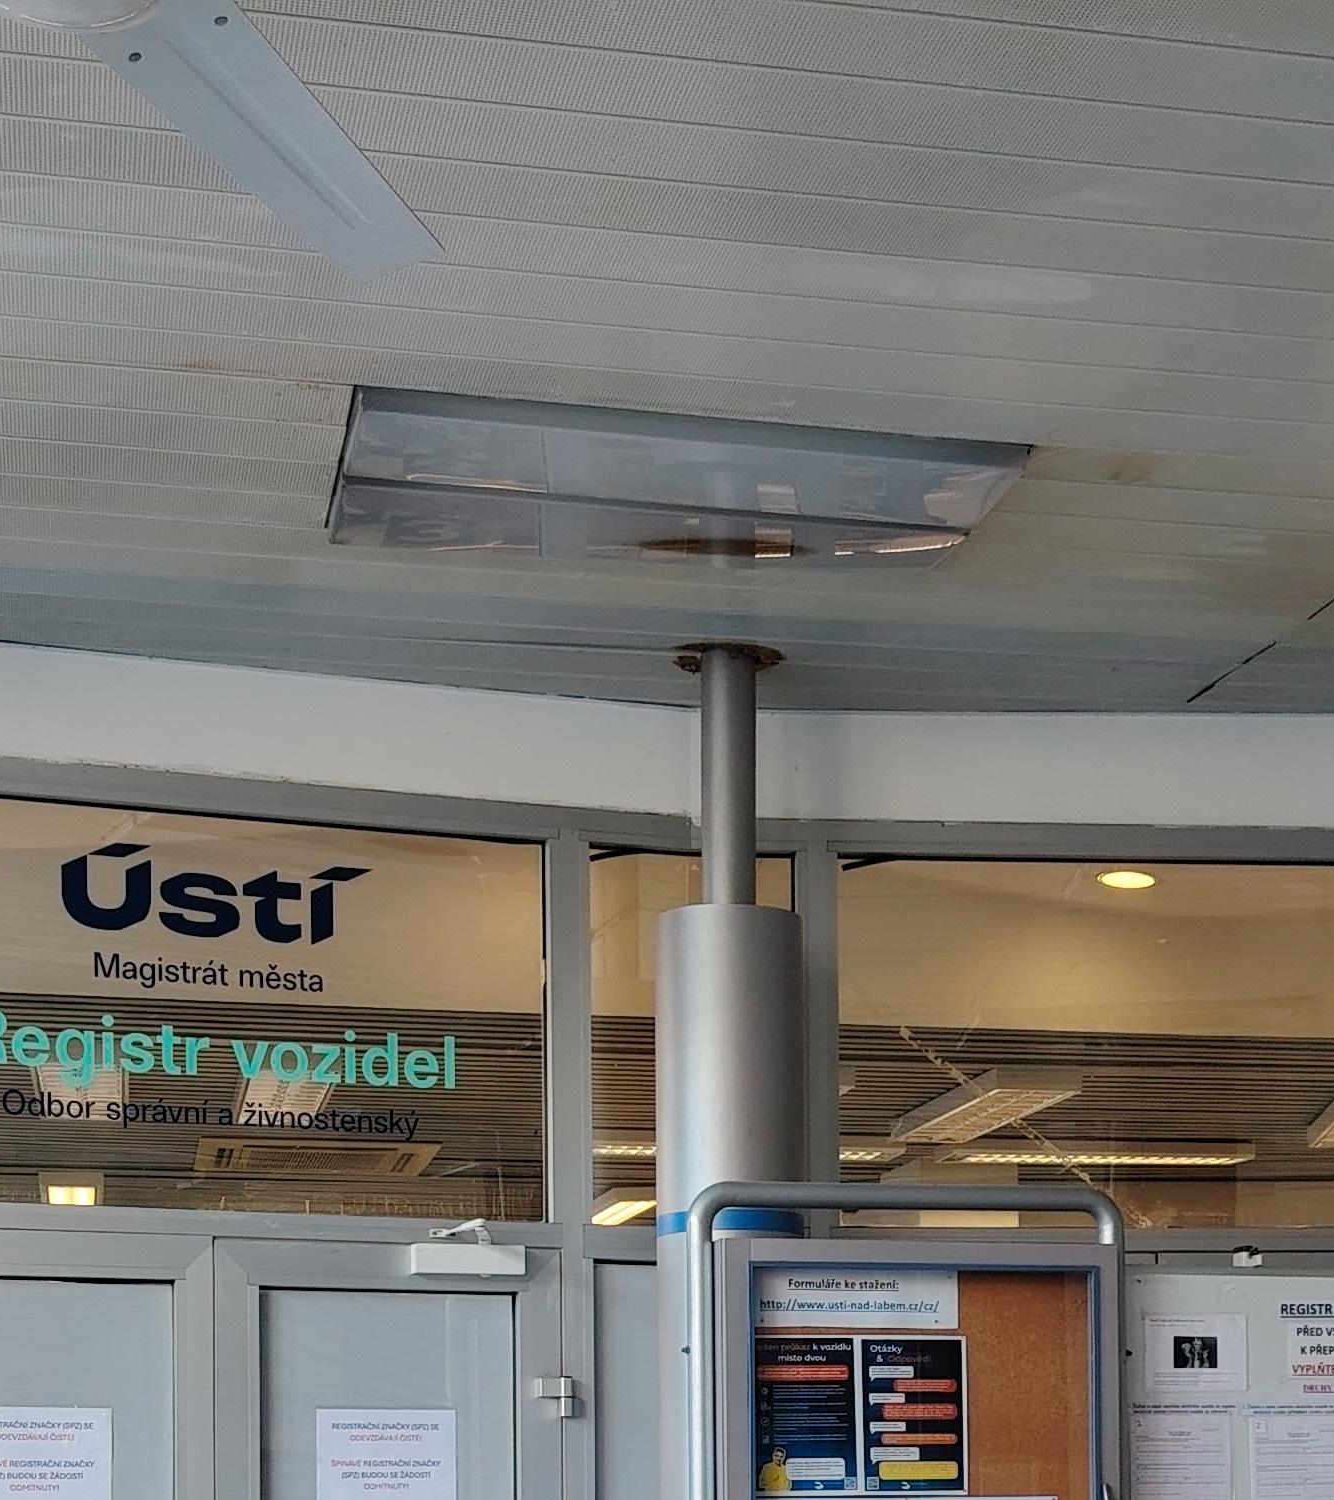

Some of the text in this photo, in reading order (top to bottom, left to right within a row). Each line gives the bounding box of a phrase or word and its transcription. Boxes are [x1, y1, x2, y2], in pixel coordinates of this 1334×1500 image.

[60, 842, 373, 945] Ústí
[93, 951, 324, 992] Magistrát města
[230, 1029, 457, 1090] vozidel
[2, 1088, 419, 1141] Odbor správní a živnostenský
[788, 1278, 841, 1290] Formuláře
[844, 1279, 857, 1290] ke
[1280, 1303, 1333, 1315] REGISTR
[1296, 1324, 1323, 1337] PŘED
[813, 1343, 818, 1351] k
[820, 1343, 852, 1352] vozidlu
[869, 1343, 903, 1355] Otázky
[1300, 1345, 1307, 1355] K
[804, 1353, 827, 1363] dvou
[29, 1420, 61, 1429] ZNAČKY
[331, 1421, 380, 1430] REGISTRAČNÍ
[381, 1421, 411, 1431] ZNAČKY
[9, 1458, 62, 1468] REGISTRAČNÍ
[63, 1458, 95, 1468] ZNAČKY
